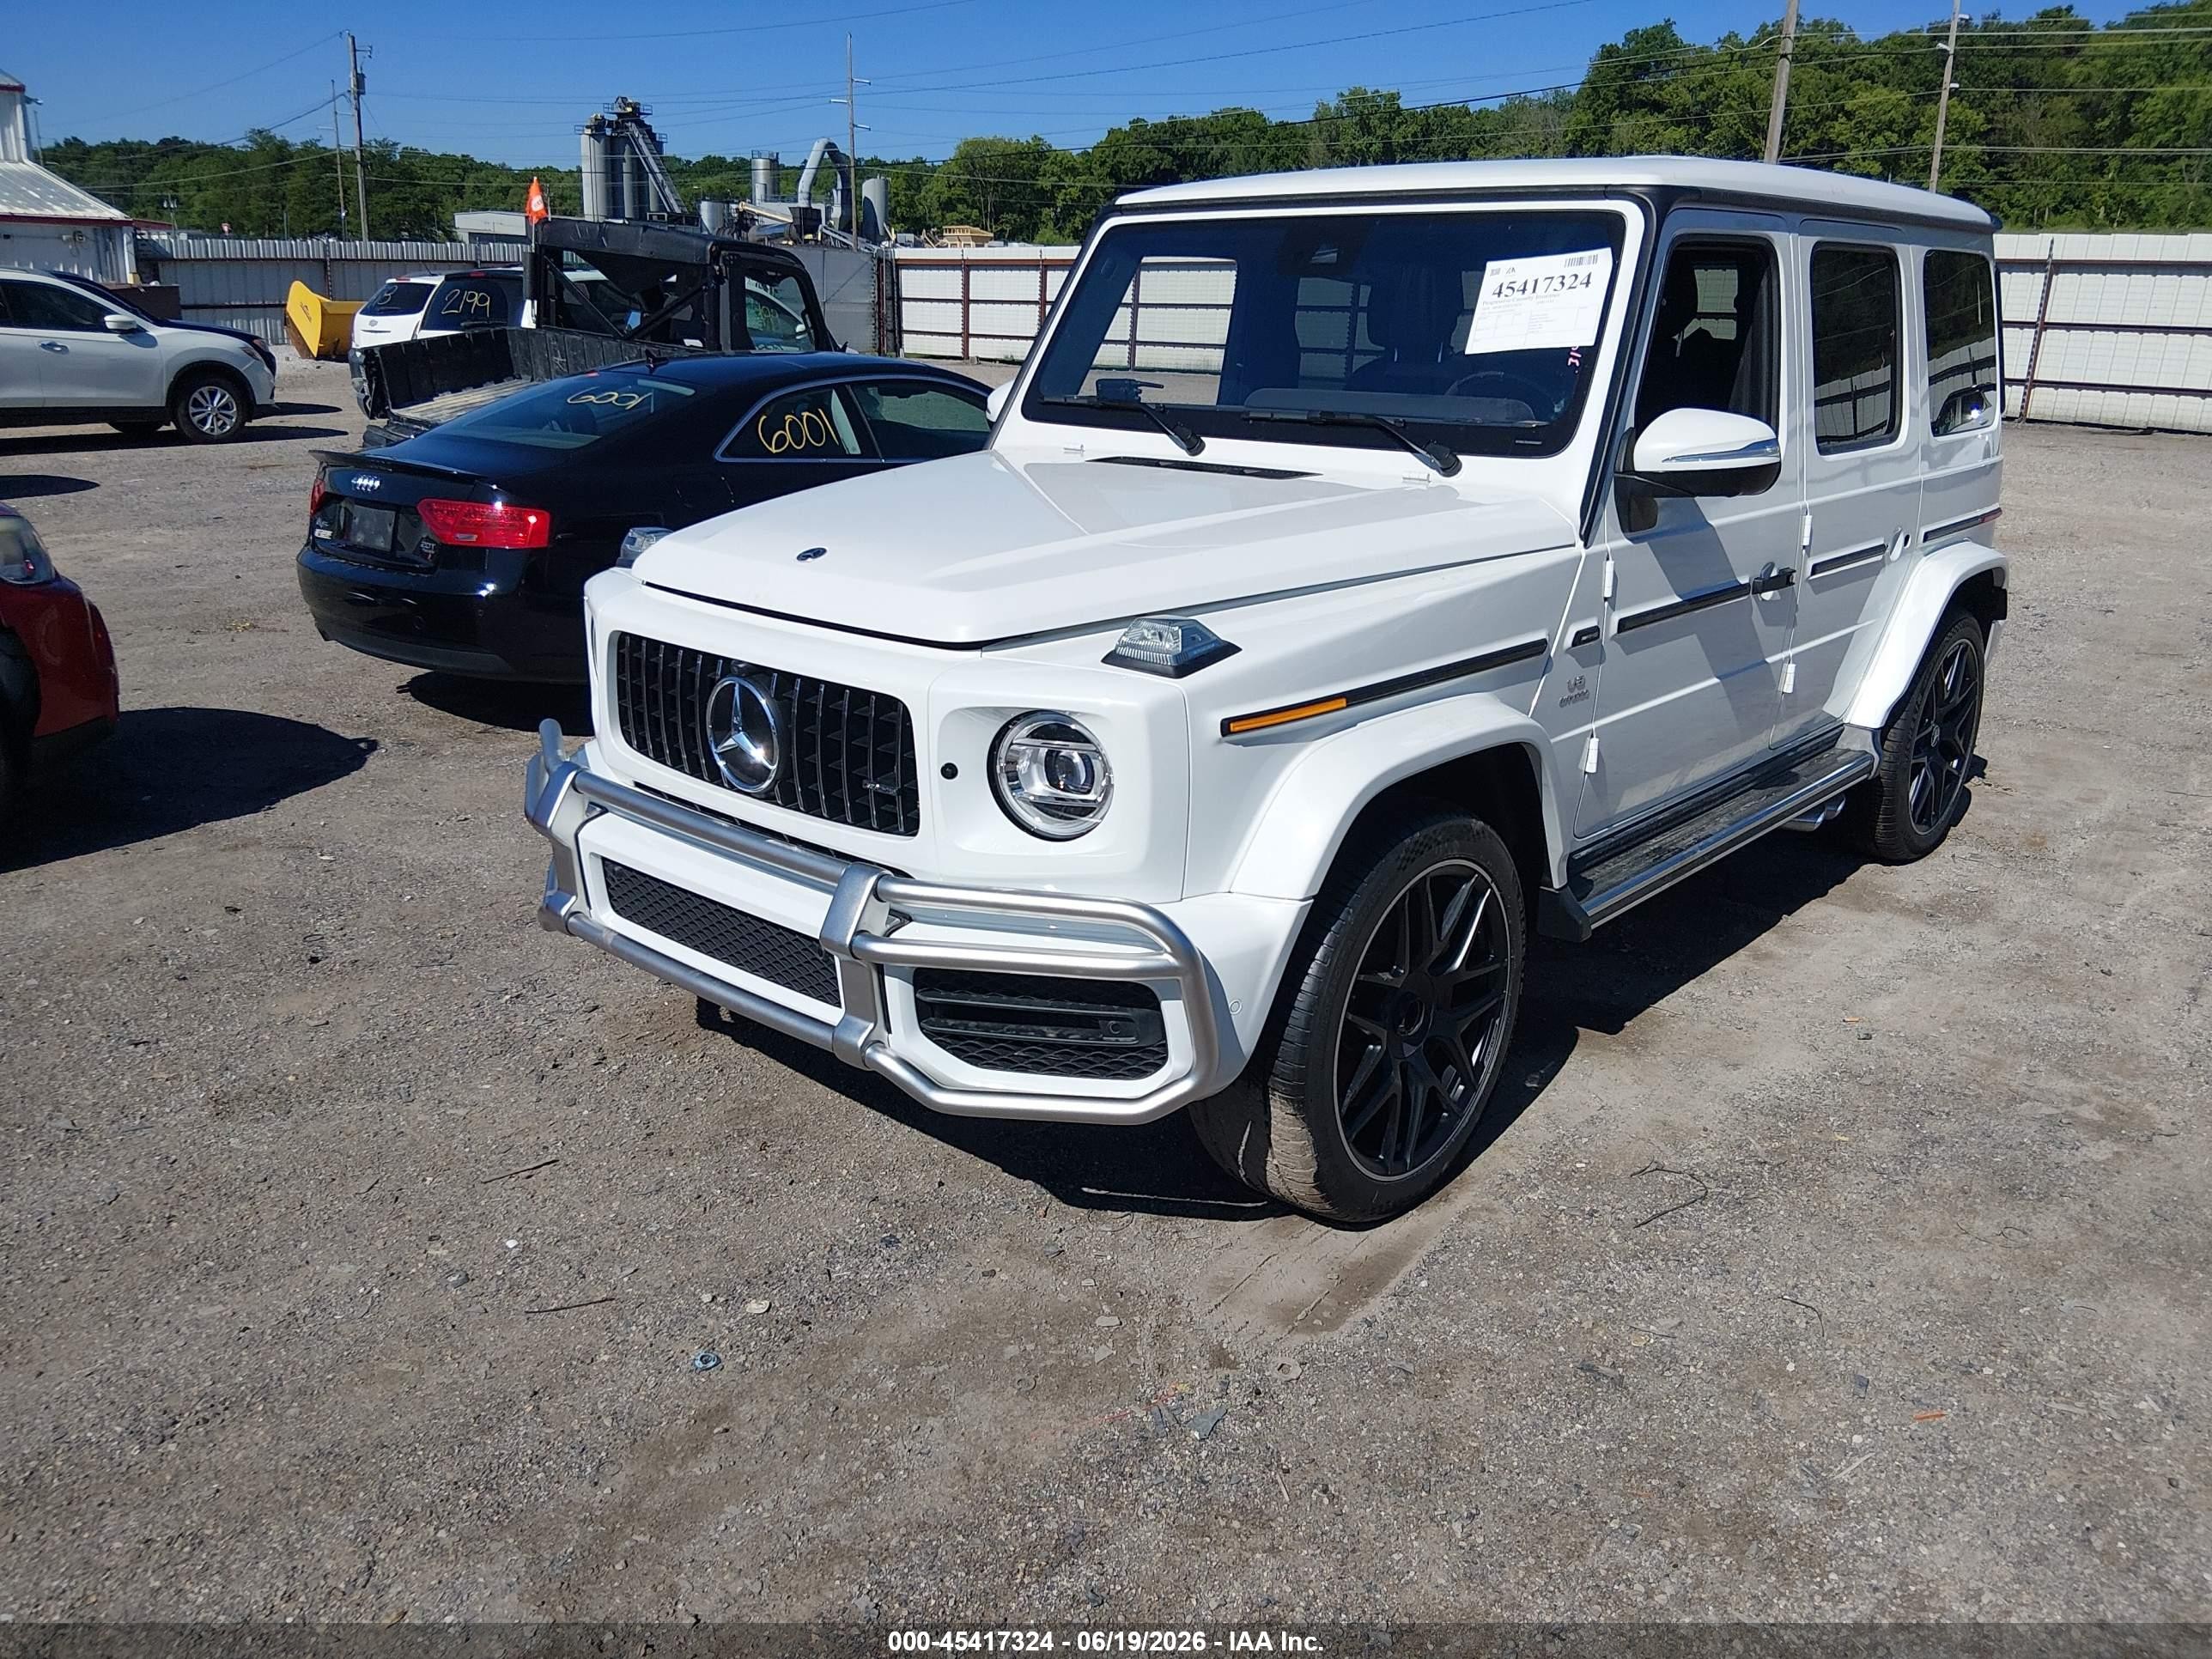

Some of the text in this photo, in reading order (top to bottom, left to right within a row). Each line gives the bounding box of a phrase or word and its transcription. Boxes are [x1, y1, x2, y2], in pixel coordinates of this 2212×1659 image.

[1492, 270, 1593, 298] 45417324
[441, 289, 490, 318] 2199
[757, 408, 840, 453] 6001
